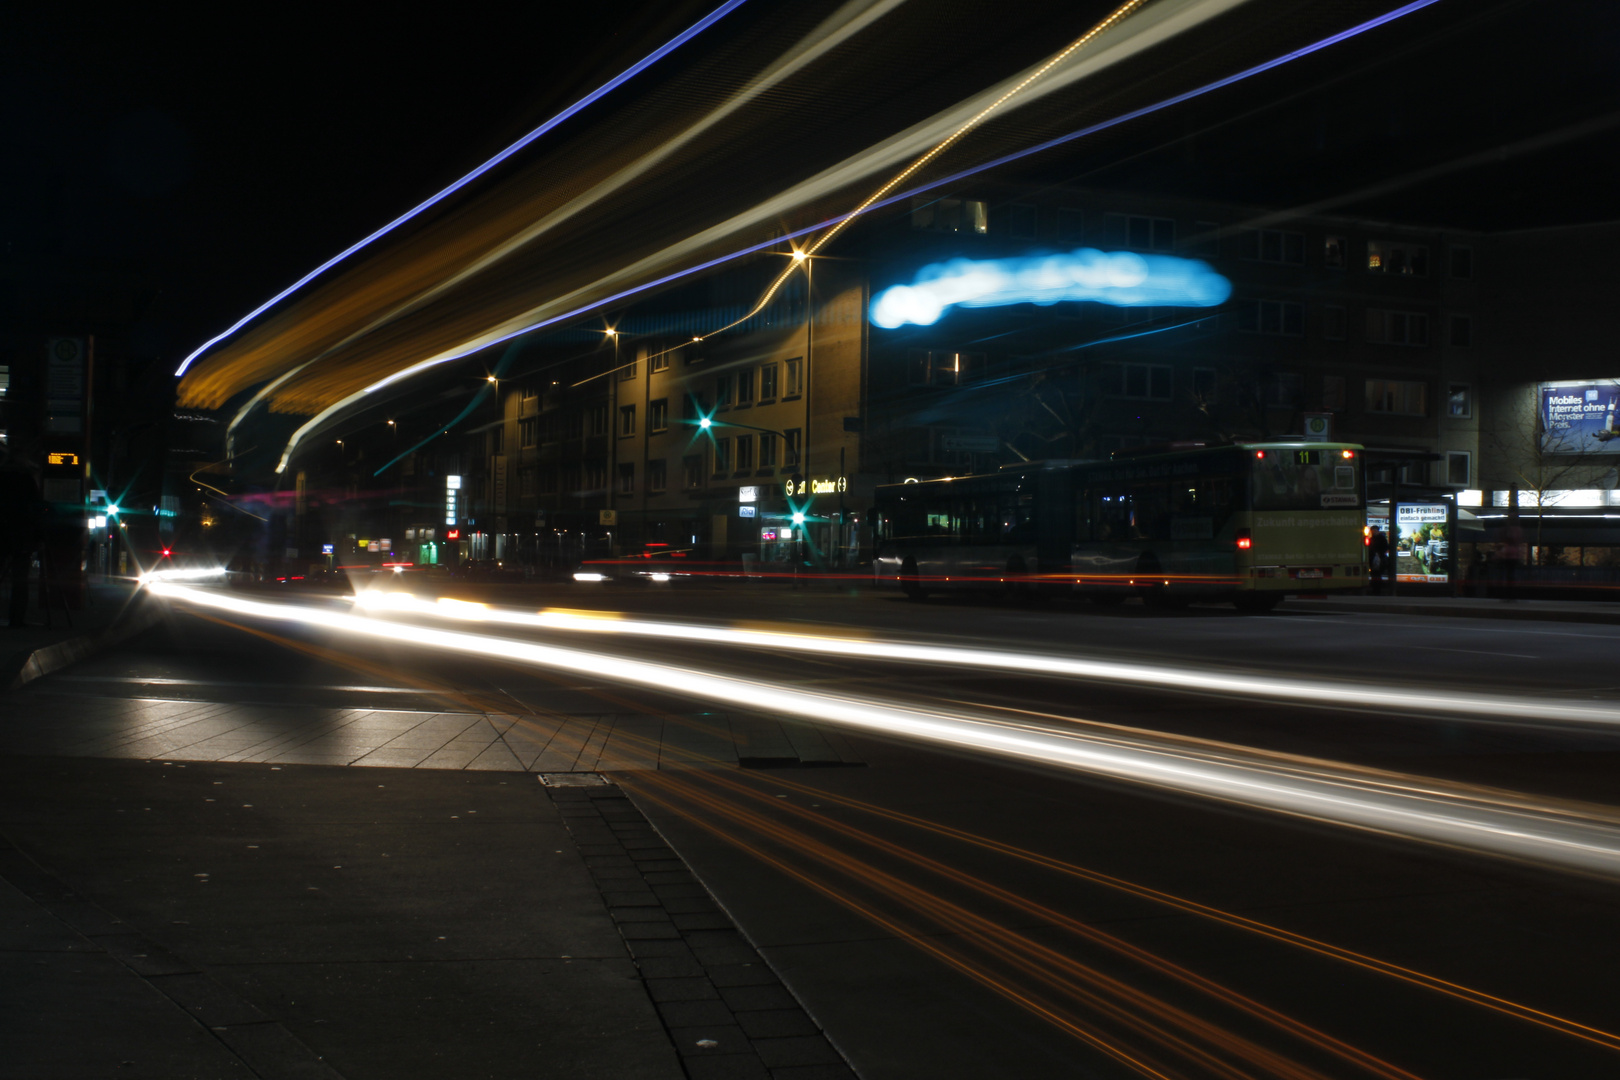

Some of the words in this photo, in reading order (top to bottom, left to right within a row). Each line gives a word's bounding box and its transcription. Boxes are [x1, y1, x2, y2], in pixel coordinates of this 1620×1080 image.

[1549, 395, 1583, 405] Mobiles
[1549, 404, 1583, 413] Internet
[1583, 403, 1606, 412] ohne
[1549, 412, 1585, 421] Monster
[1299, 450, 1310, 464] 11
[811, 479, 836, 494] Center
[447, 489, 456, 525] HOTEL
[1400, 507, 1445, 515] OBI-Frühling
[1256, 517, 1295, 527] Zukunft
[1297, 516, 1357, 528] angeschaltet
